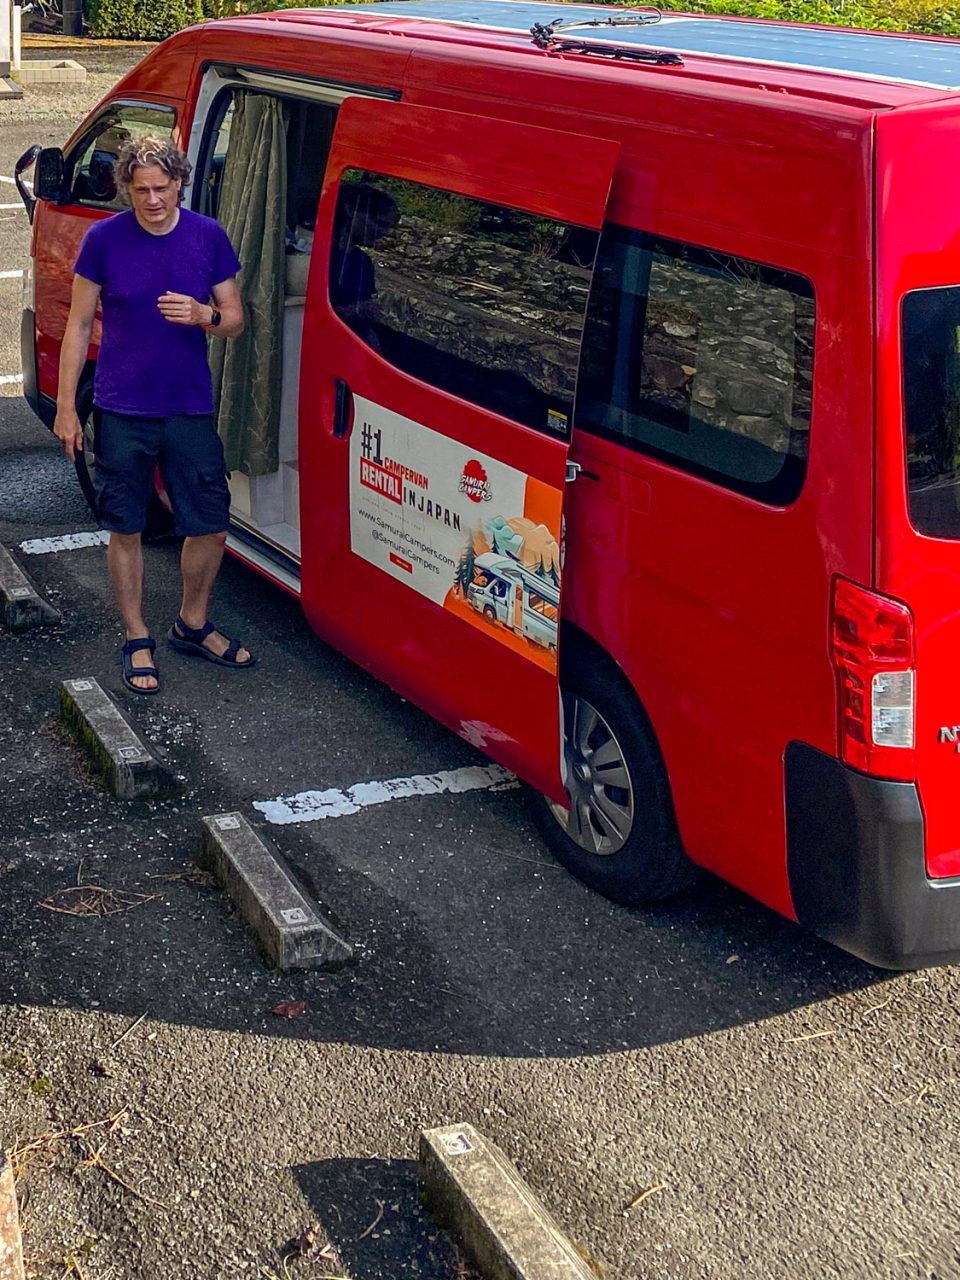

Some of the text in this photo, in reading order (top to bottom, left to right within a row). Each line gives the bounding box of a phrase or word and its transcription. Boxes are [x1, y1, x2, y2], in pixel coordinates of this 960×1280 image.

[361, 422, 383, 466] #1
[362, 463, 400, 500] RENTAL
[384, 457, 428, 490] CAMPERVAN
[460, 474, 490, 490] SAMURAI
[358, 509, 456, 568] www.SamuraiCampers.com
[371, 529, 440, 575] @SamuraiCampers
